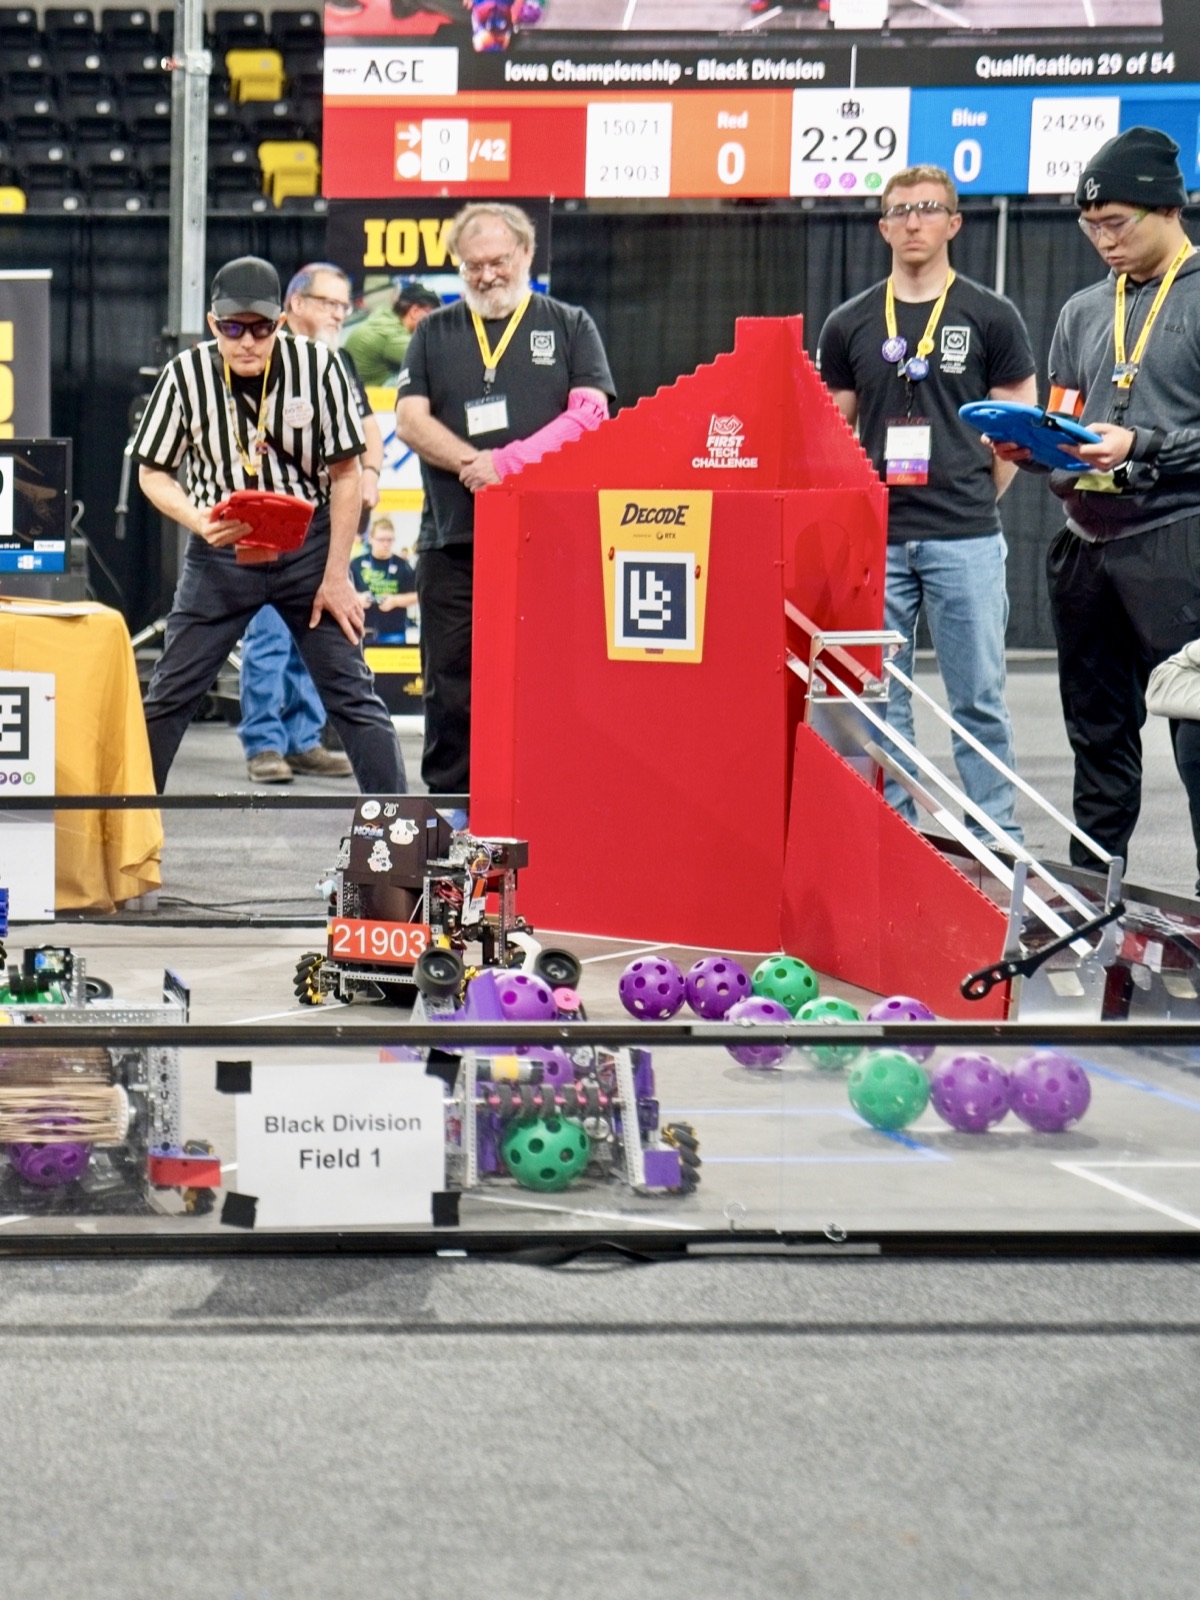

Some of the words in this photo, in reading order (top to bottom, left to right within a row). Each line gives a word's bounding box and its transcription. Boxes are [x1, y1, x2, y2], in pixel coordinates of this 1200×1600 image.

[505, 60, 549, 82] Iowa
[551, 59, 681, 85] Championship
[696, 58, 749, 81] Black
[751, 58, 825, 80] Division
[975, 52, 1094, 79] Qualification
[1097, 54, 1122, 75] 29
[1126, 53, 1147, 75] of
[1150, 52, 1175, 74] 54
[602, 119, 659, 135] 15071
[717, 110, 748, 129] Red
[951, 108, 987, 127] Blue
[1043, 113, 1105, 131] 24296
[439, 128, 451, 145] 0
[801, 126, 897, 162] 2:29
[469, 138, 507, 163] /42
[953, 138, 982, 182] 0
[438, 157, 450, 174] 0
[717, 141, 746, 184] 0
[1046, 160, 1083, 177] 893
[600, 166, 660, 181] 21903
[363, 219, 459, 267] IOW
[706, 435, 745, 448] FIRST
[708, 448, 739, 458] TECH
[692, 457, 758, 469] CHALLENGE
[620, 502, 690, 527] DECODE
[333, 923, 427, 957] 21903
[265, 1115, 325, 1133] Black
[333, 1113, 422, 1132] Division
[300, 1148, 360, 1169] Field
[370, 1148, 381, 1168] 1
